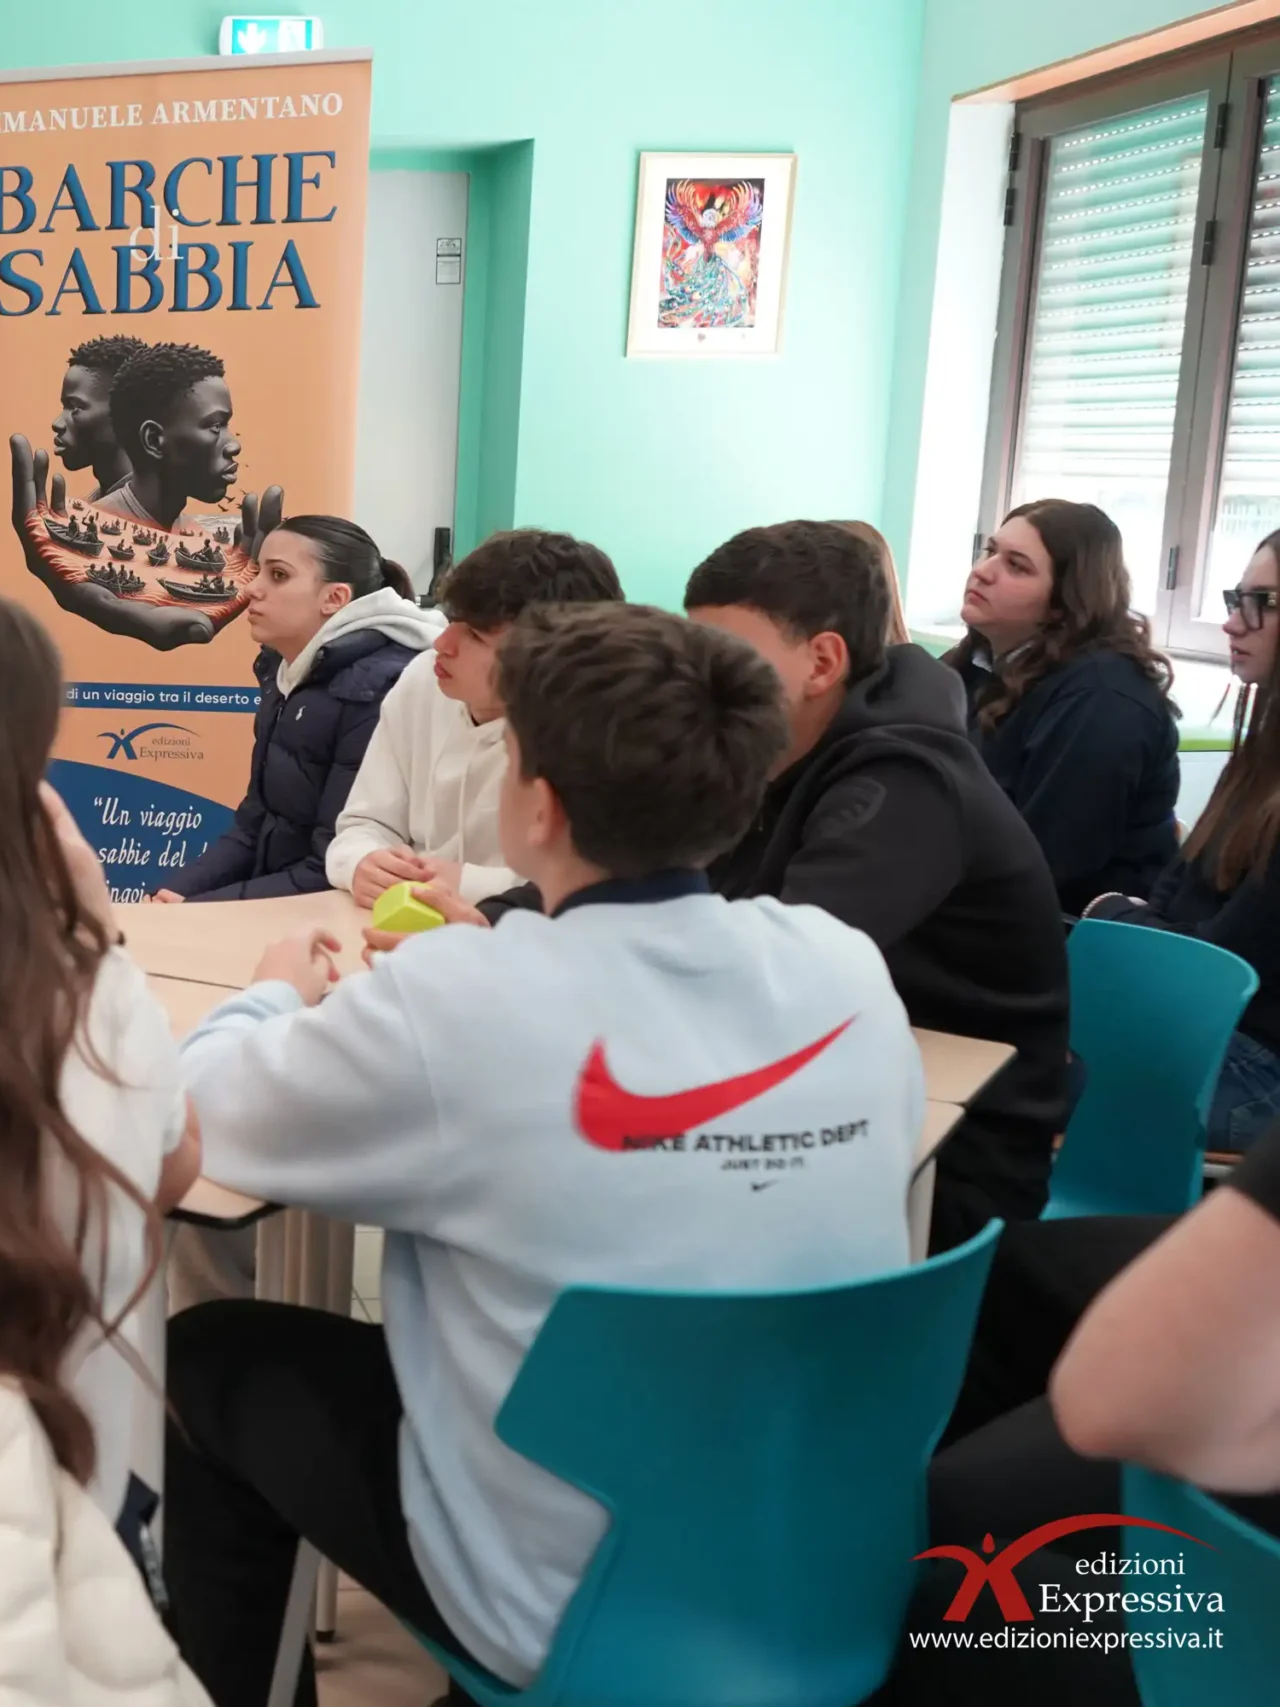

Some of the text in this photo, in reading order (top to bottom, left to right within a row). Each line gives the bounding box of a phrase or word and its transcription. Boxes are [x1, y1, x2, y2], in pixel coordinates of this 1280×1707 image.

[150, 92, 344, 125] ARMENTANO
[128, 205, 185, 262] di
[66, 688, 262, 705] di un viaggio tra il deserto e
[139, 747, 205, 762] Expressiva
[151, 737, 191, 747] edizioni
[140, 803, 203, 836] viaggio
[98, 837, 151, 866] sabbie
[158, 839, 186, 868] del
[693, 1130, 816, 1153] ATHLETIC
[819, 1117, 870, 1147] DEPT
